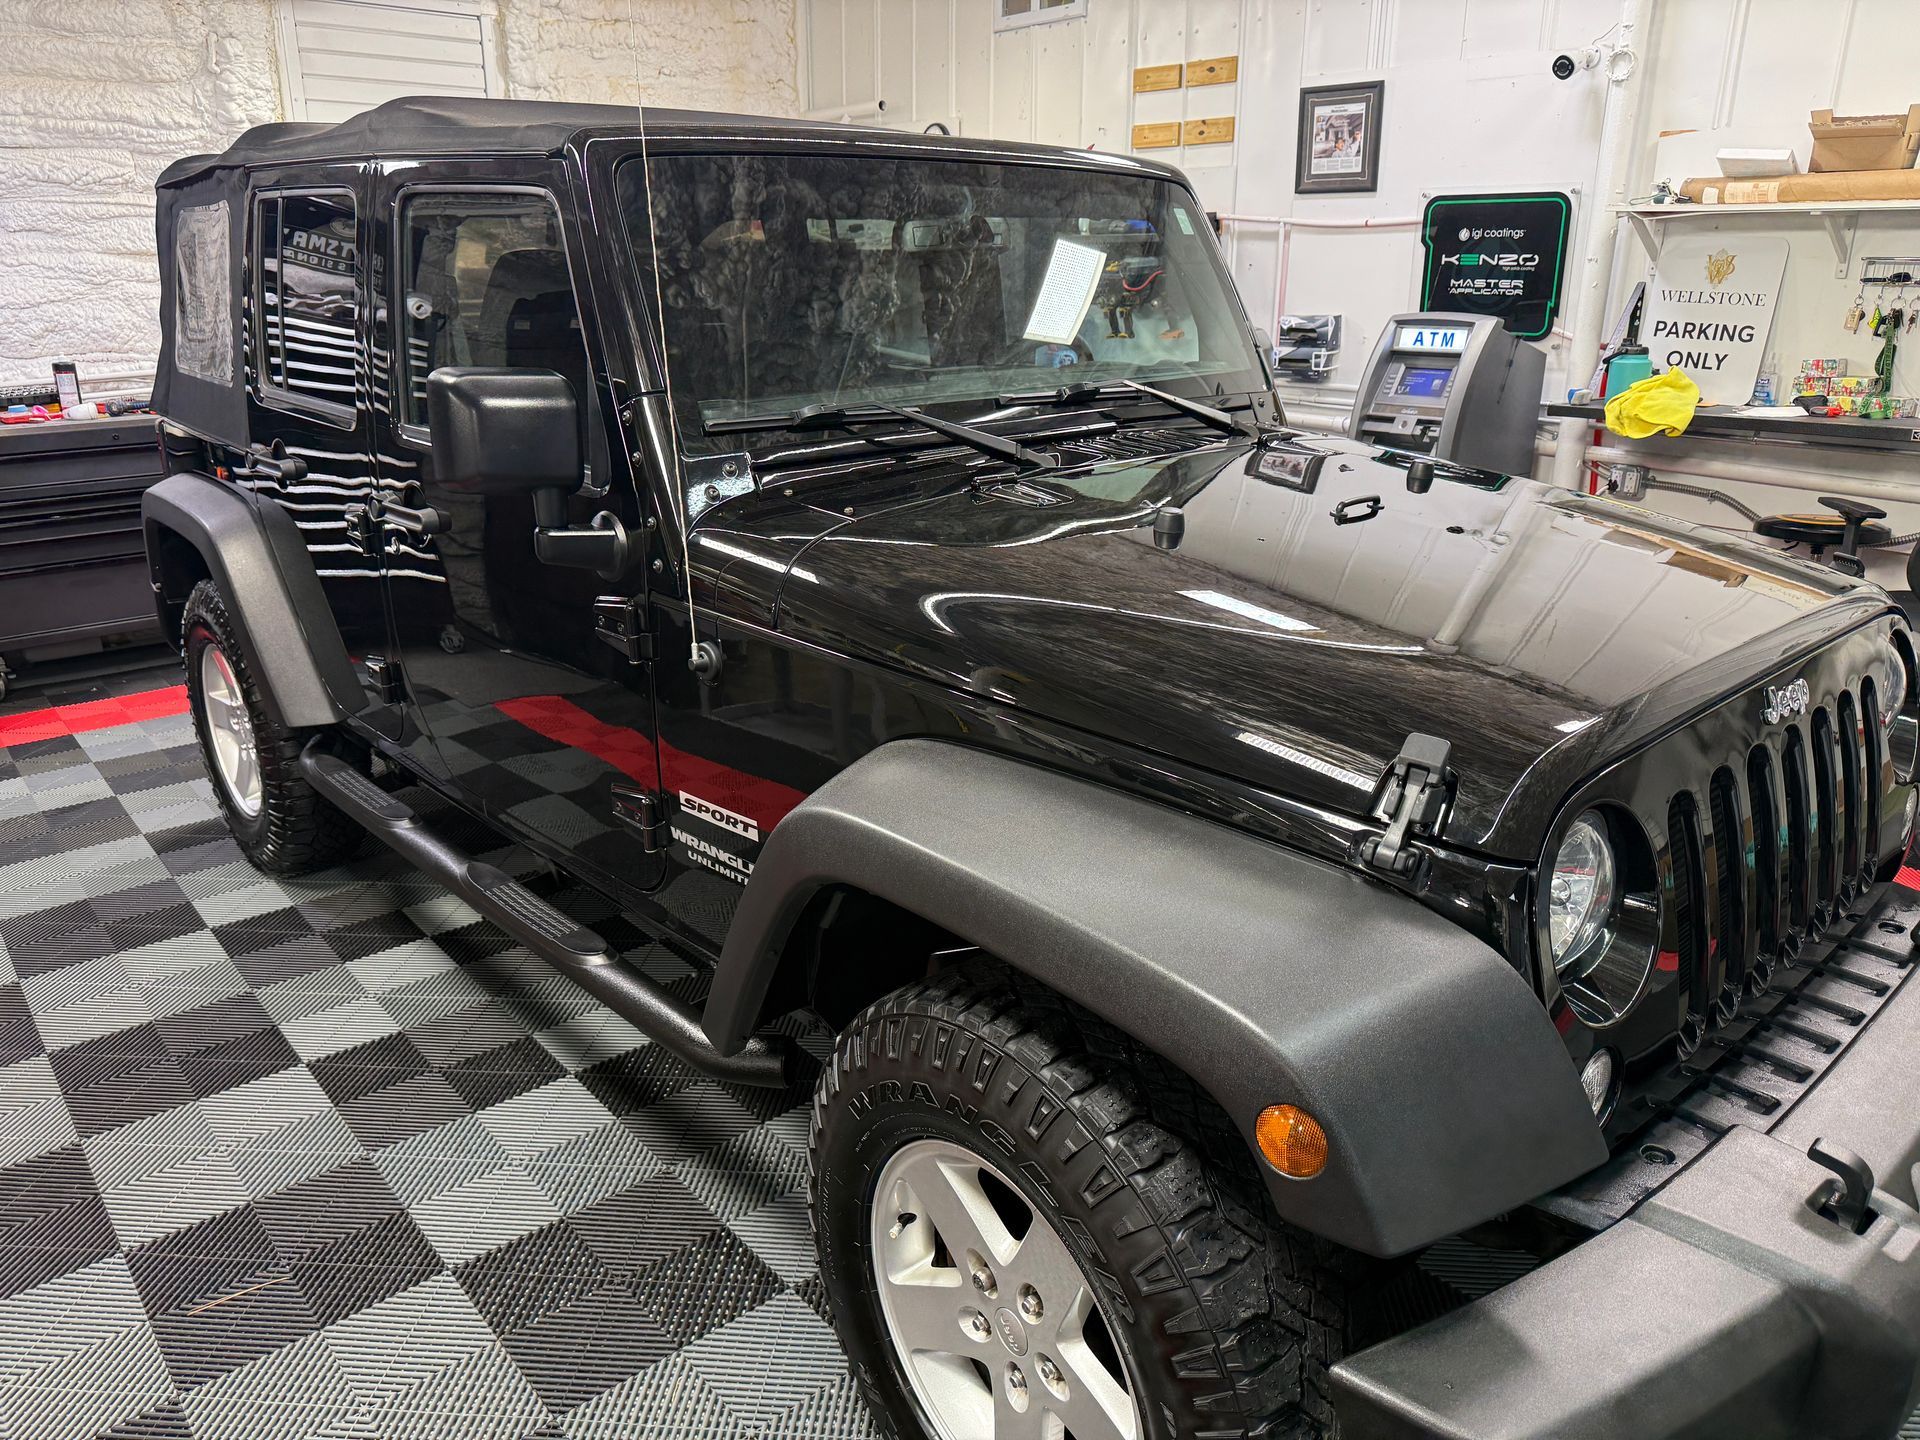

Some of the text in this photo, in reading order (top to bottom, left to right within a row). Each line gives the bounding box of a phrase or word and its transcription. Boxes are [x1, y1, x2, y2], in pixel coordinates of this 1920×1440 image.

[1471, 227, 1525, 240] igl coatings
[1441, 253, 1540, 266] KENZO
[1448, 287, 1524, 296] APPLICATOR
[1450, 278, 1524, 289] MASTER
[1661, 289, 1767, 307] WELLSTONE
[1412, 331, 1456, 348] ATM
[1653, 320, 1756, 343] PARKING
[1666, 350, 1729, 371] ONLY
[1763, 678, 1810, 724] Jeep
[680, 797, 758, 834] SPORT
[670, 826, 755, 875] WRANGL
[687, 850, 749, 886] UNLIMIT
[848, 1079, 1136, 1324] WRANGLER
